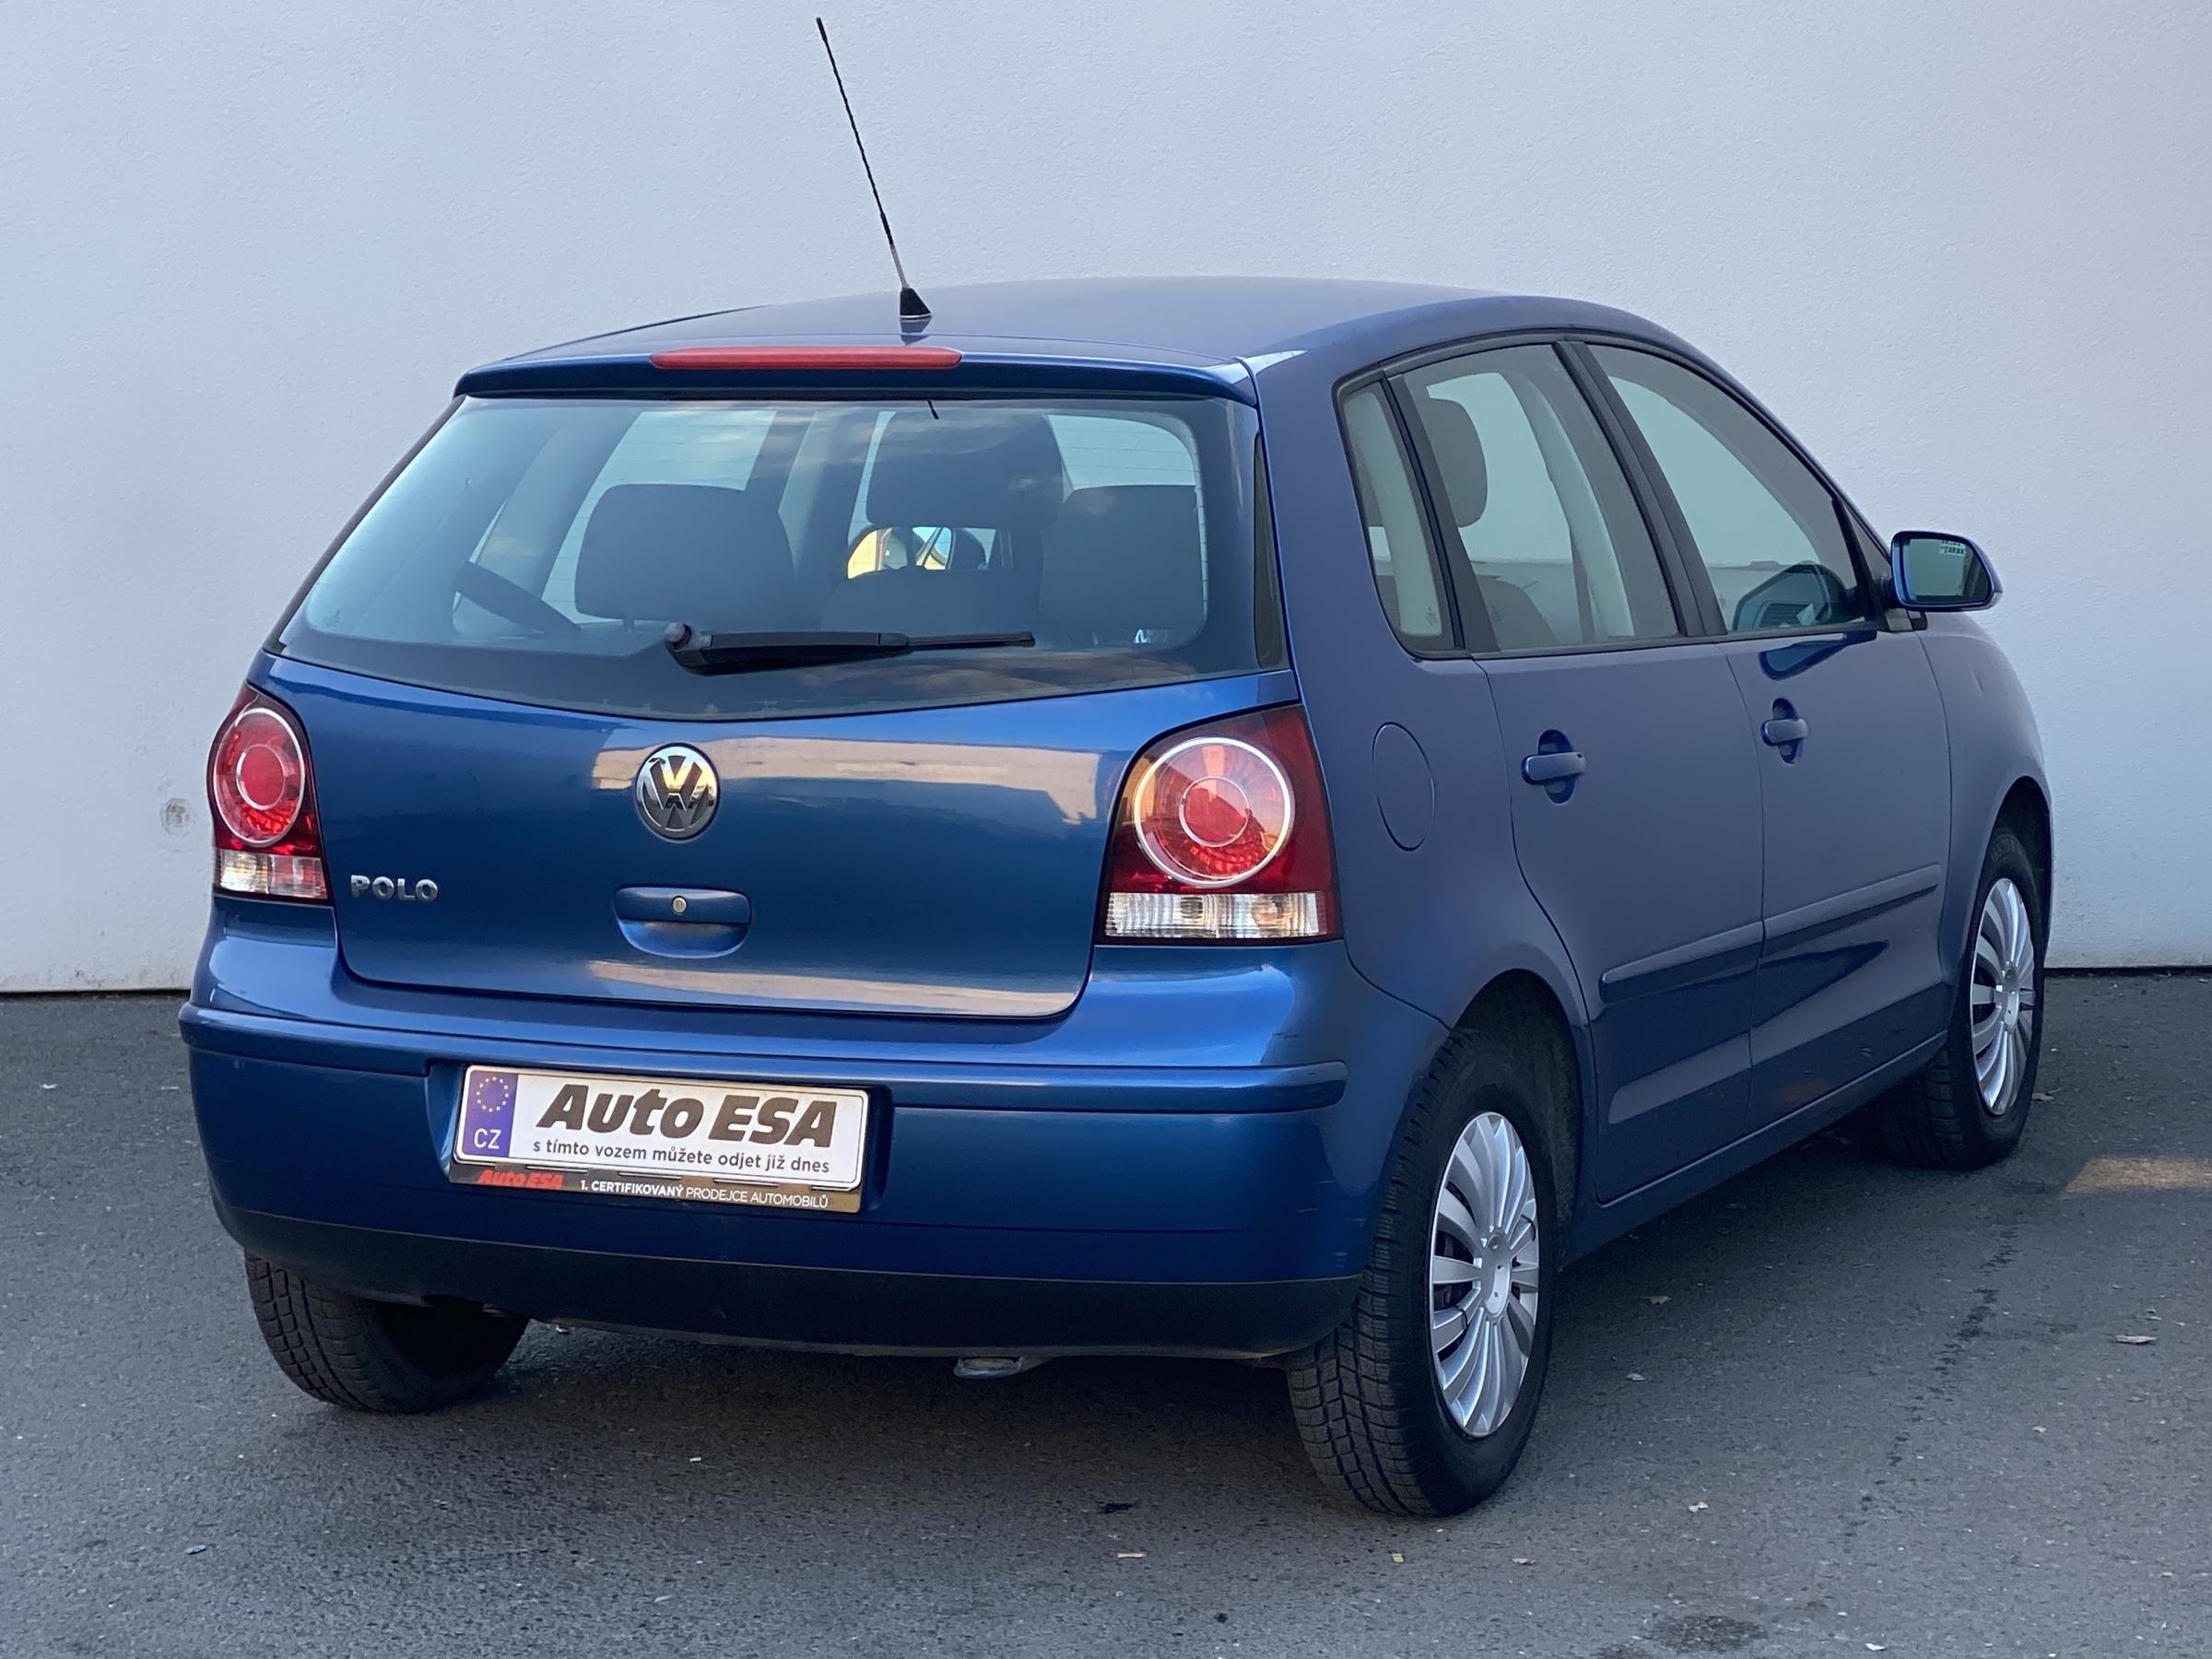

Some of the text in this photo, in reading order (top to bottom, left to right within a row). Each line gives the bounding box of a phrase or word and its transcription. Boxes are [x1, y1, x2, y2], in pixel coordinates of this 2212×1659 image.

[350, 875, 438, 901] POLO
[535, 1084, 837, 1147] Auto ESA
[474, 1128, 501, 1149] CZ
[533, 1137, 830, 1173] s tímto vozem můžete odjet již dnes
[477, 1170, 564, 1189] Auto ESA
[581, 1180, 829, 1208] 1. CERTIFIKOVANÝ PRODEJCE AUTOMOBILŮ
